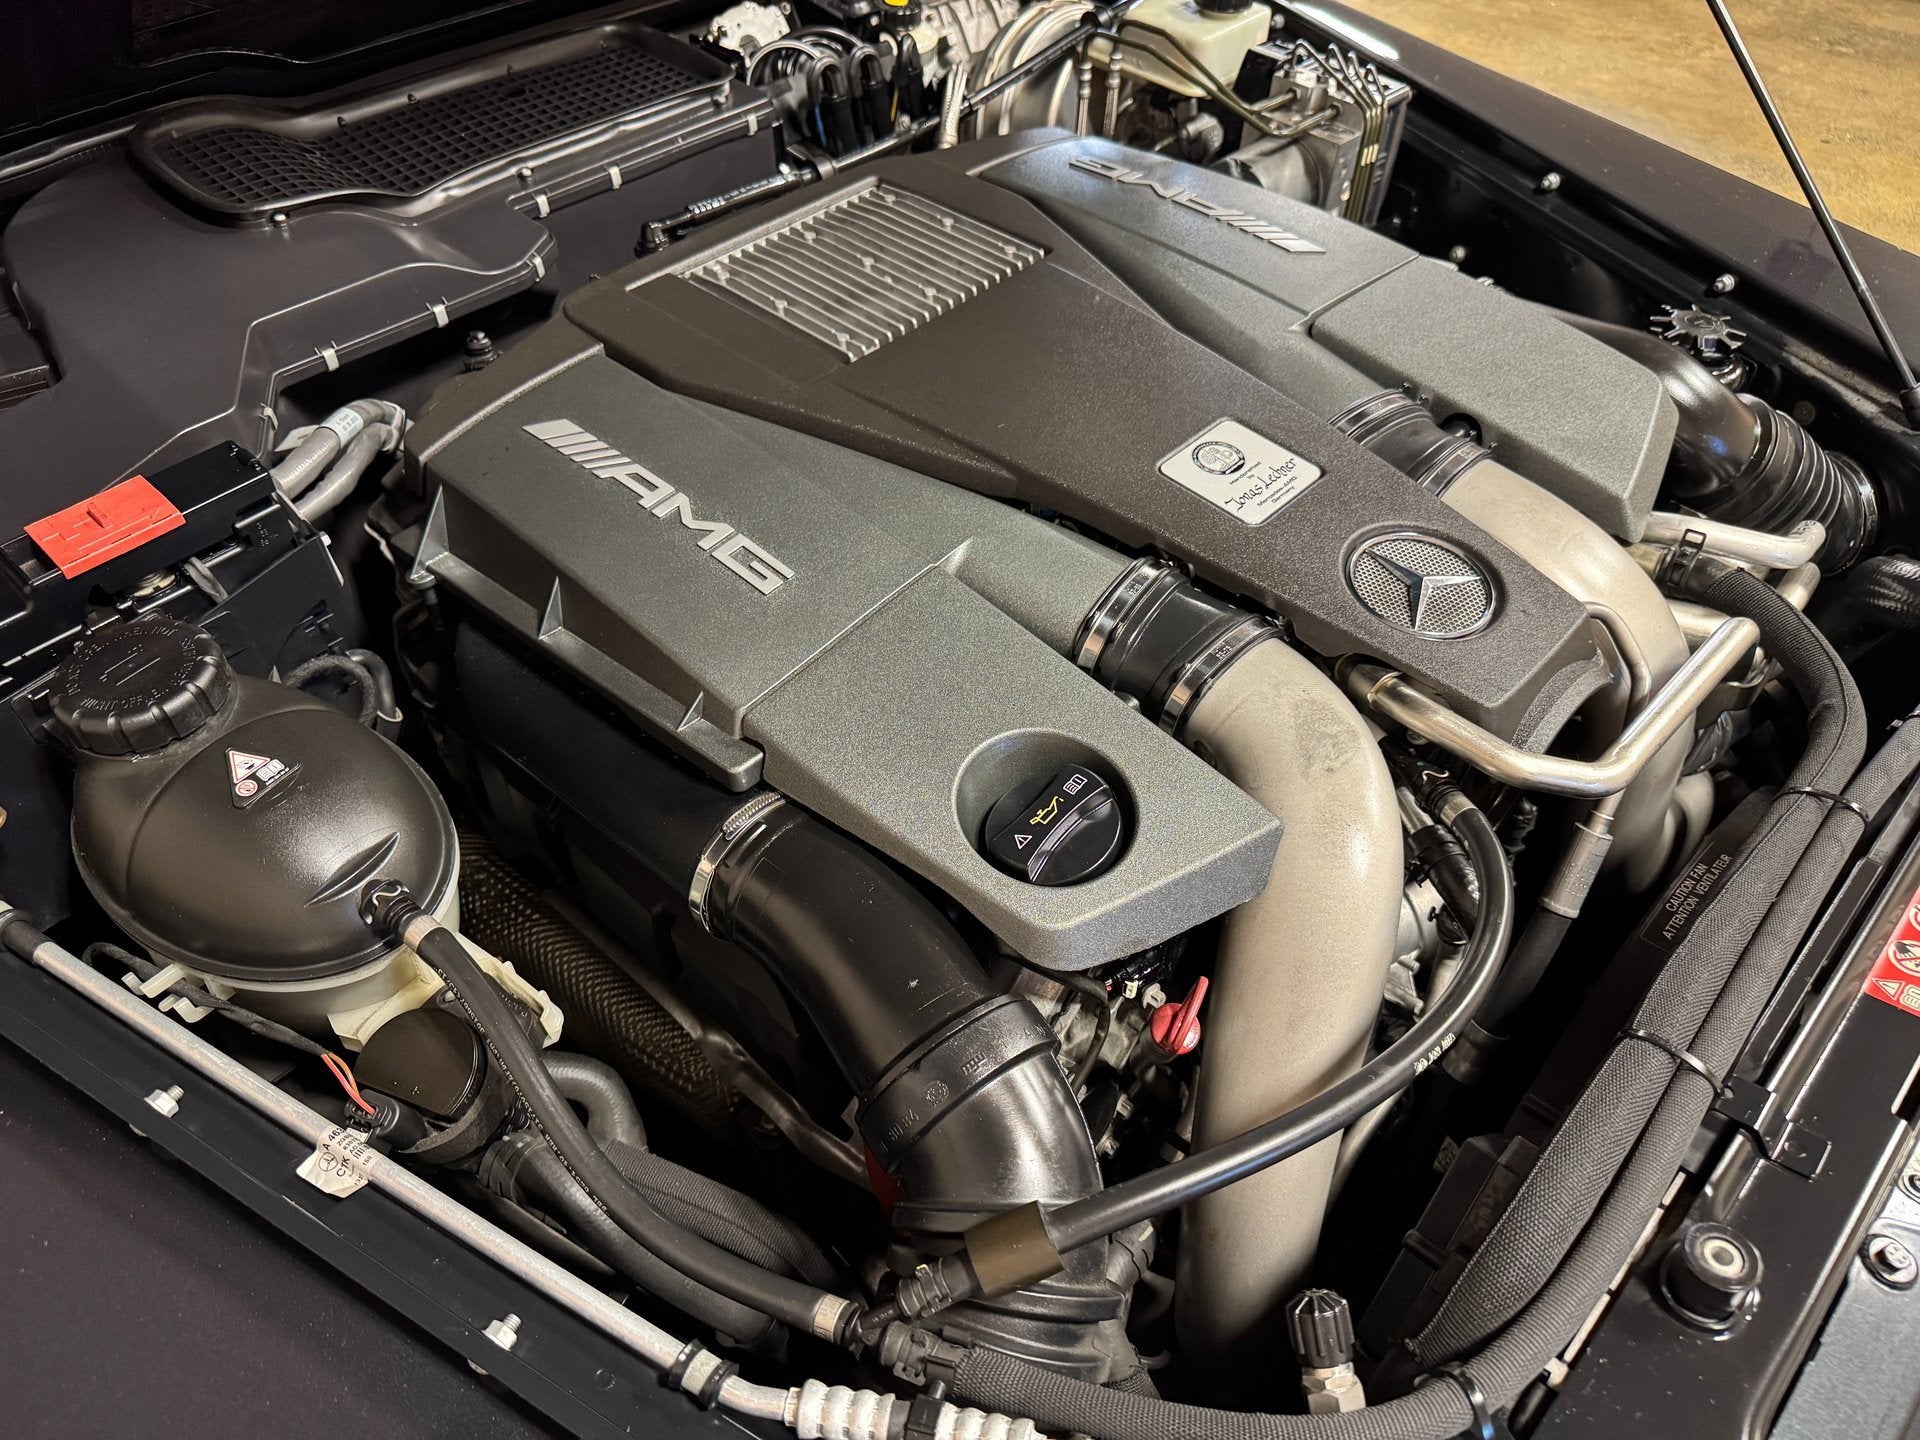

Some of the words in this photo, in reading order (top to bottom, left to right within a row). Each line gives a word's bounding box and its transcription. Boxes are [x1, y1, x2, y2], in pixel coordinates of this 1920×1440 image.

[1224, 483, 1264, 513] Jonas
[1257, 476, 1298, 507] Mercedes-AMG
[1272, 486, 1295, 504] Germany
[592, 463, 795, 595] AMG
[1662, 895, 1700, 940] ATTENTION
[1694, 854, 1733, 895] VENTILATEUR
[1666, 878, 1697, 912] CAUTION
[1690, 862, 1709, 880] FAN
[322, 1143, 331, 1151] A
[336, 1155, 350, 1177] CTK
